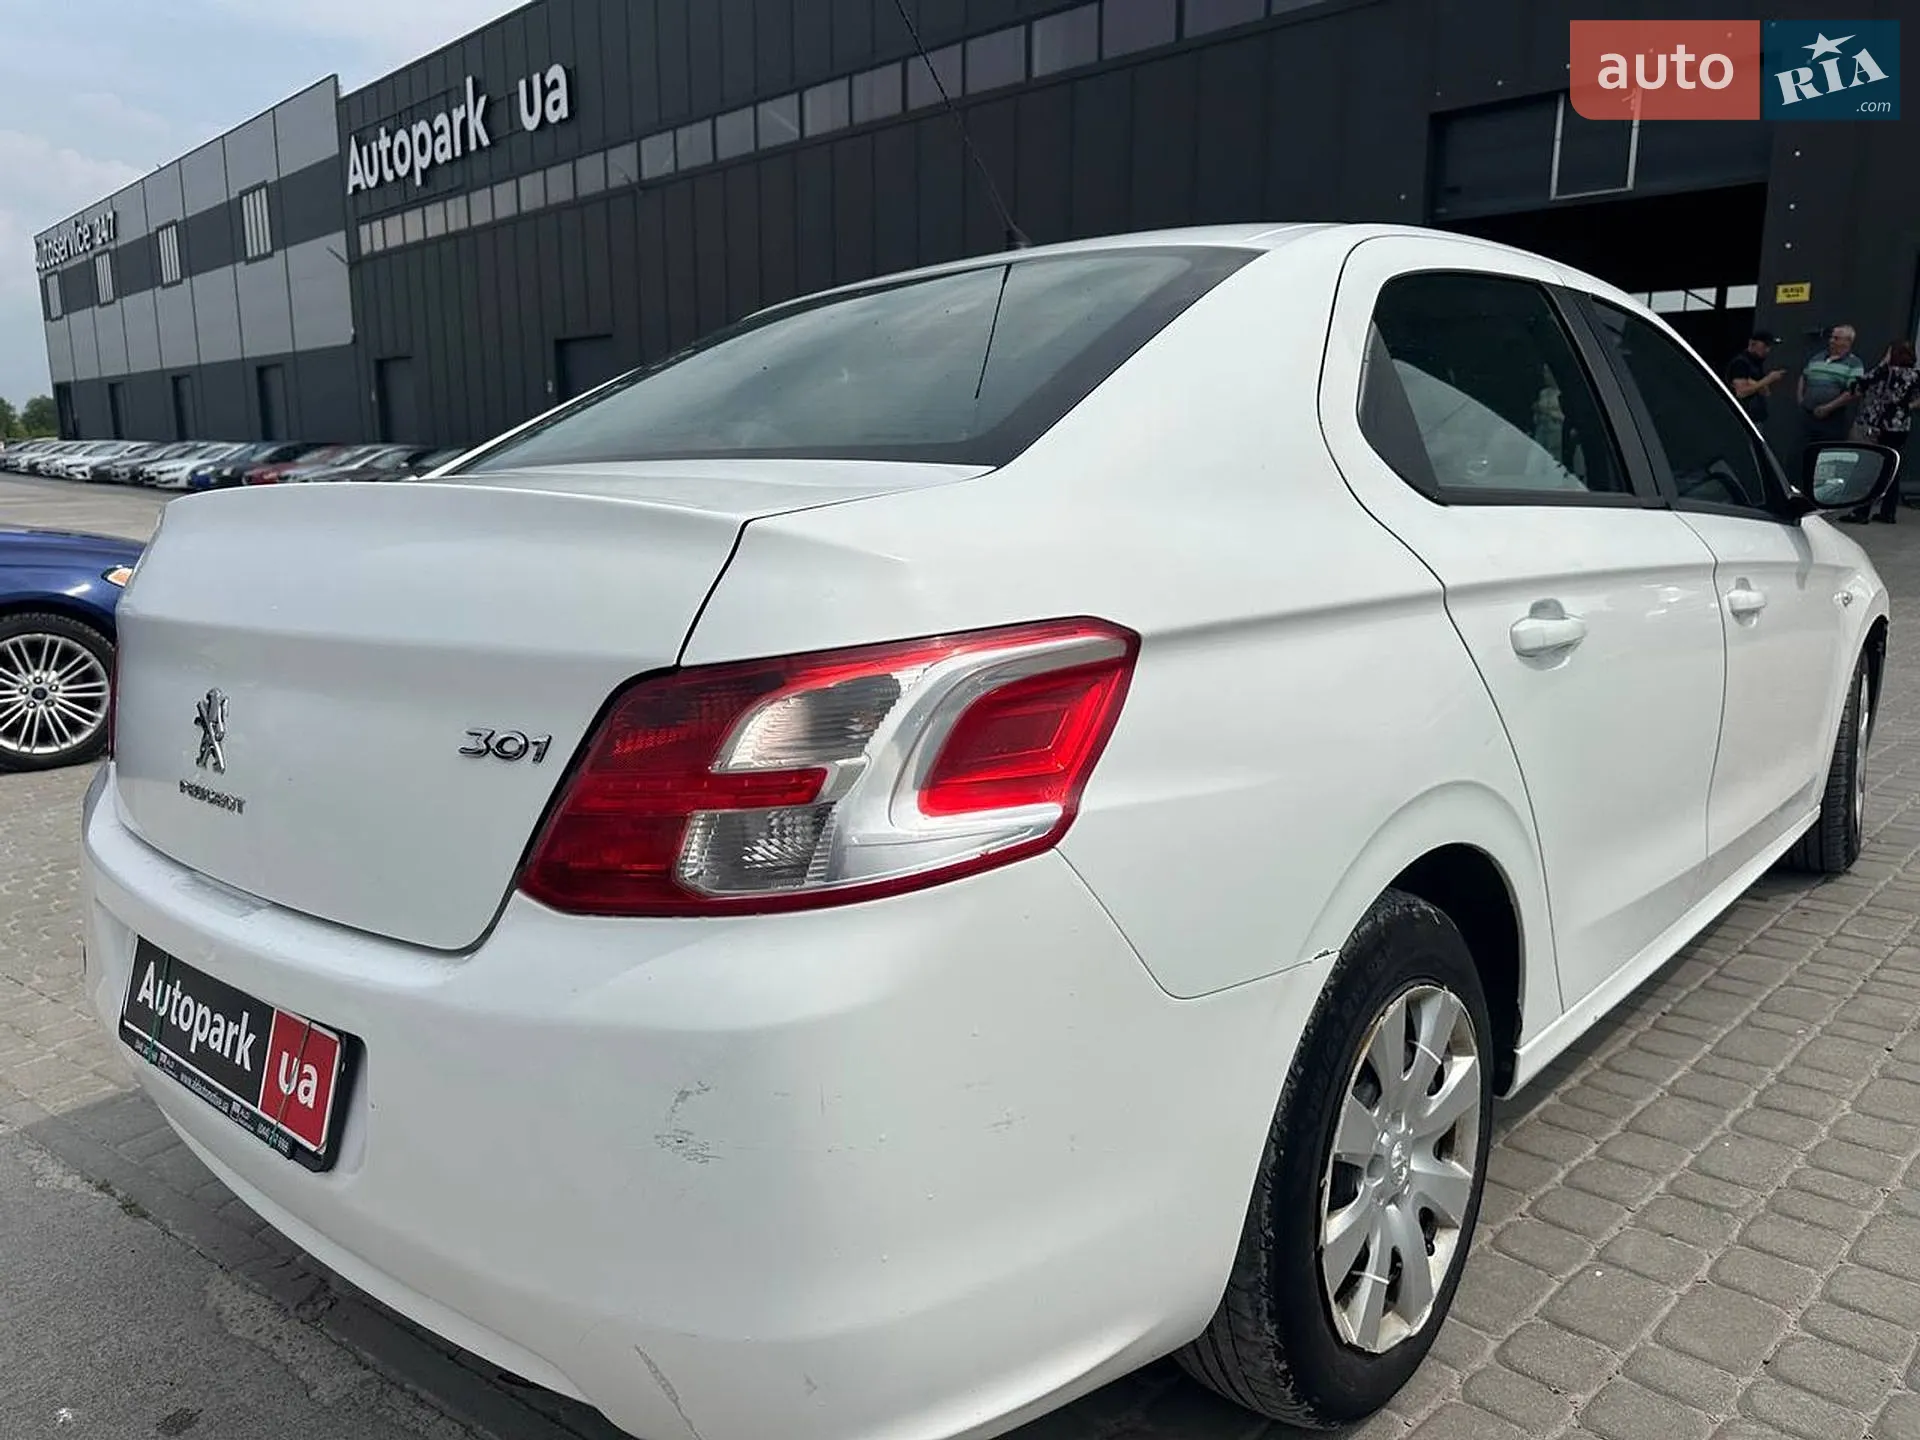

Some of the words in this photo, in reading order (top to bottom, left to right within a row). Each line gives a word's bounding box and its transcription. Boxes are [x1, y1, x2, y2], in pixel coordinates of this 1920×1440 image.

[347, 75, 491, 195] Autopark
[518, 63, 570, 131] ua
[459, 727, 553, 763] 301
[136, 961, 257, 1072] Autopark
[278, 1050, 318, 1109] ua
